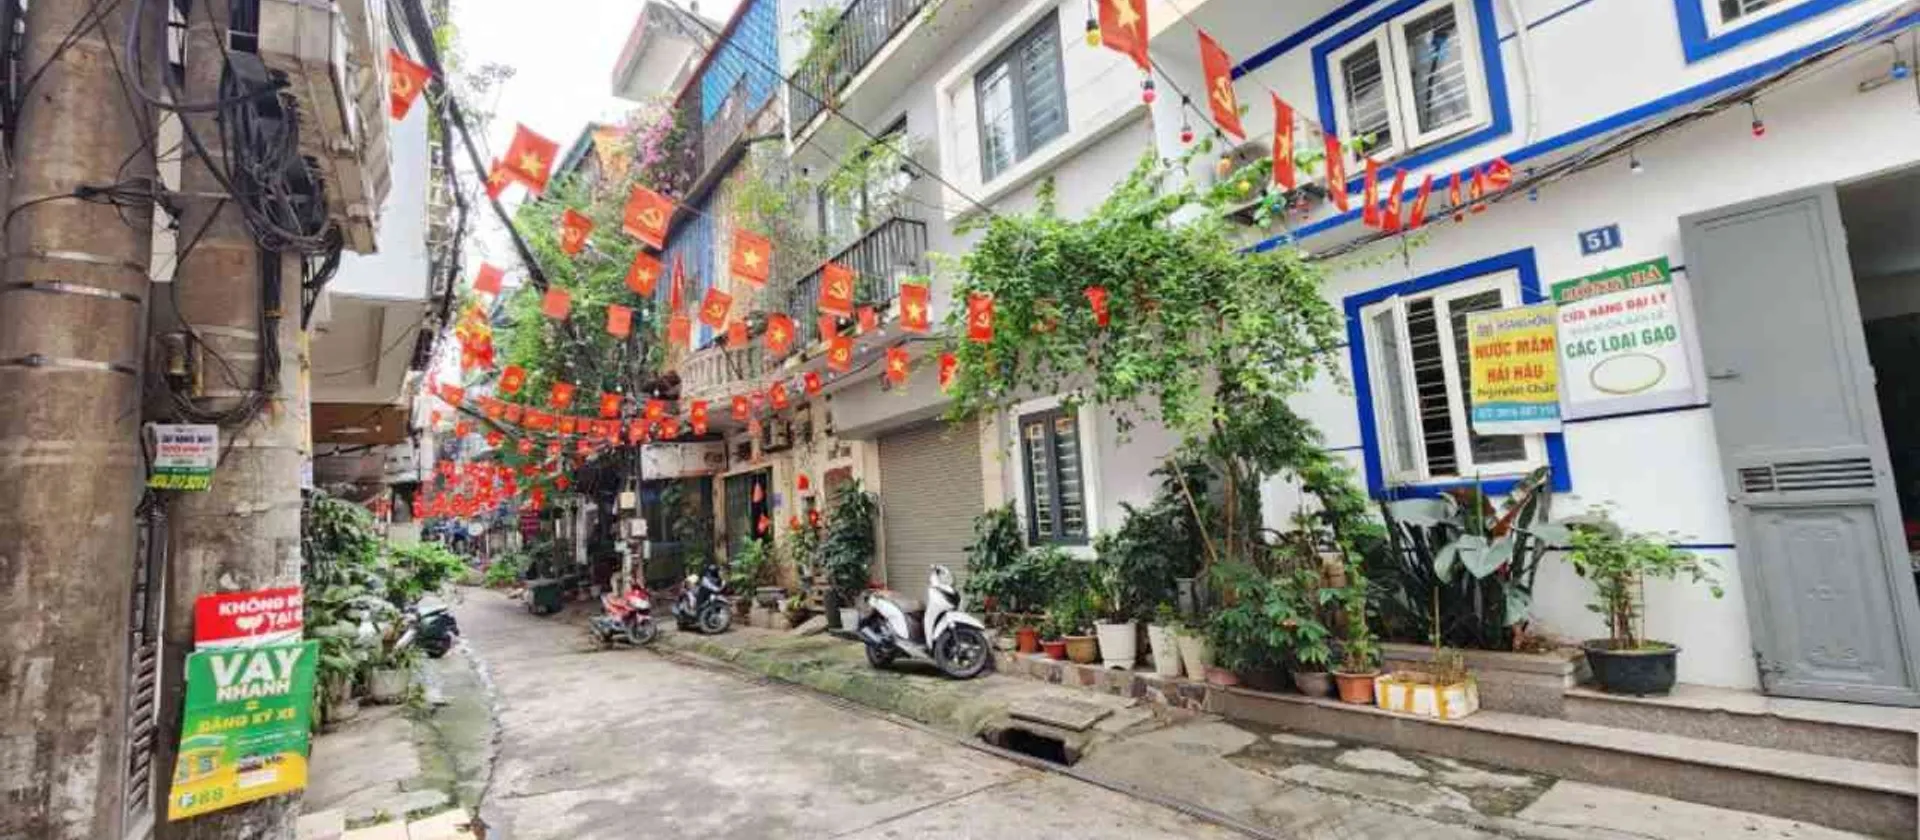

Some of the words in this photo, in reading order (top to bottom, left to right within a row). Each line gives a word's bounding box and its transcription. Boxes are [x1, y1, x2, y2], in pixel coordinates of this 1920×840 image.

[1585, 229, 1612, 250] 51
[209, 647, 303, 688] VAY
[217, 680, 290, 702] NHANH
